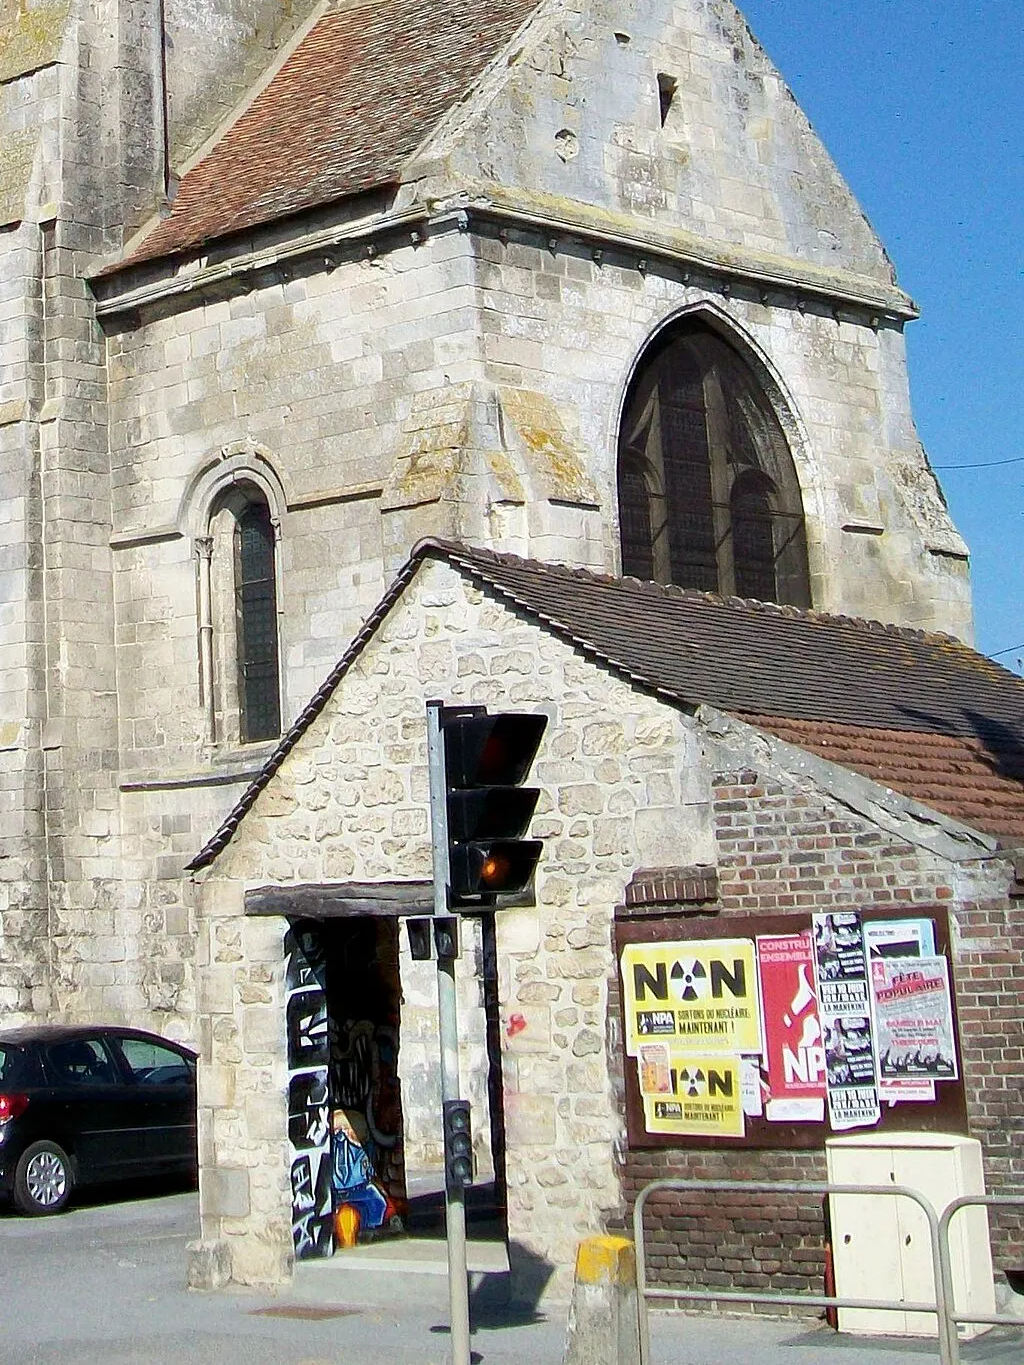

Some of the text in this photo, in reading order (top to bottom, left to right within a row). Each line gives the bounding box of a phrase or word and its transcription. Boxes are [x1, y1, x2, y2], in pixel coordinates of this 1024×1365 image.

[892, 971, 921, 984] FÊTE
[876, 978, 943, 1000] POPULAIRE
[653, 1012, 674, 1025] NPA
[678, 1009, 704, 1020] SORTONS
[706, 1009, 714, 1019] DU
[679, 1022, 728, 1034] MAINTENANT
